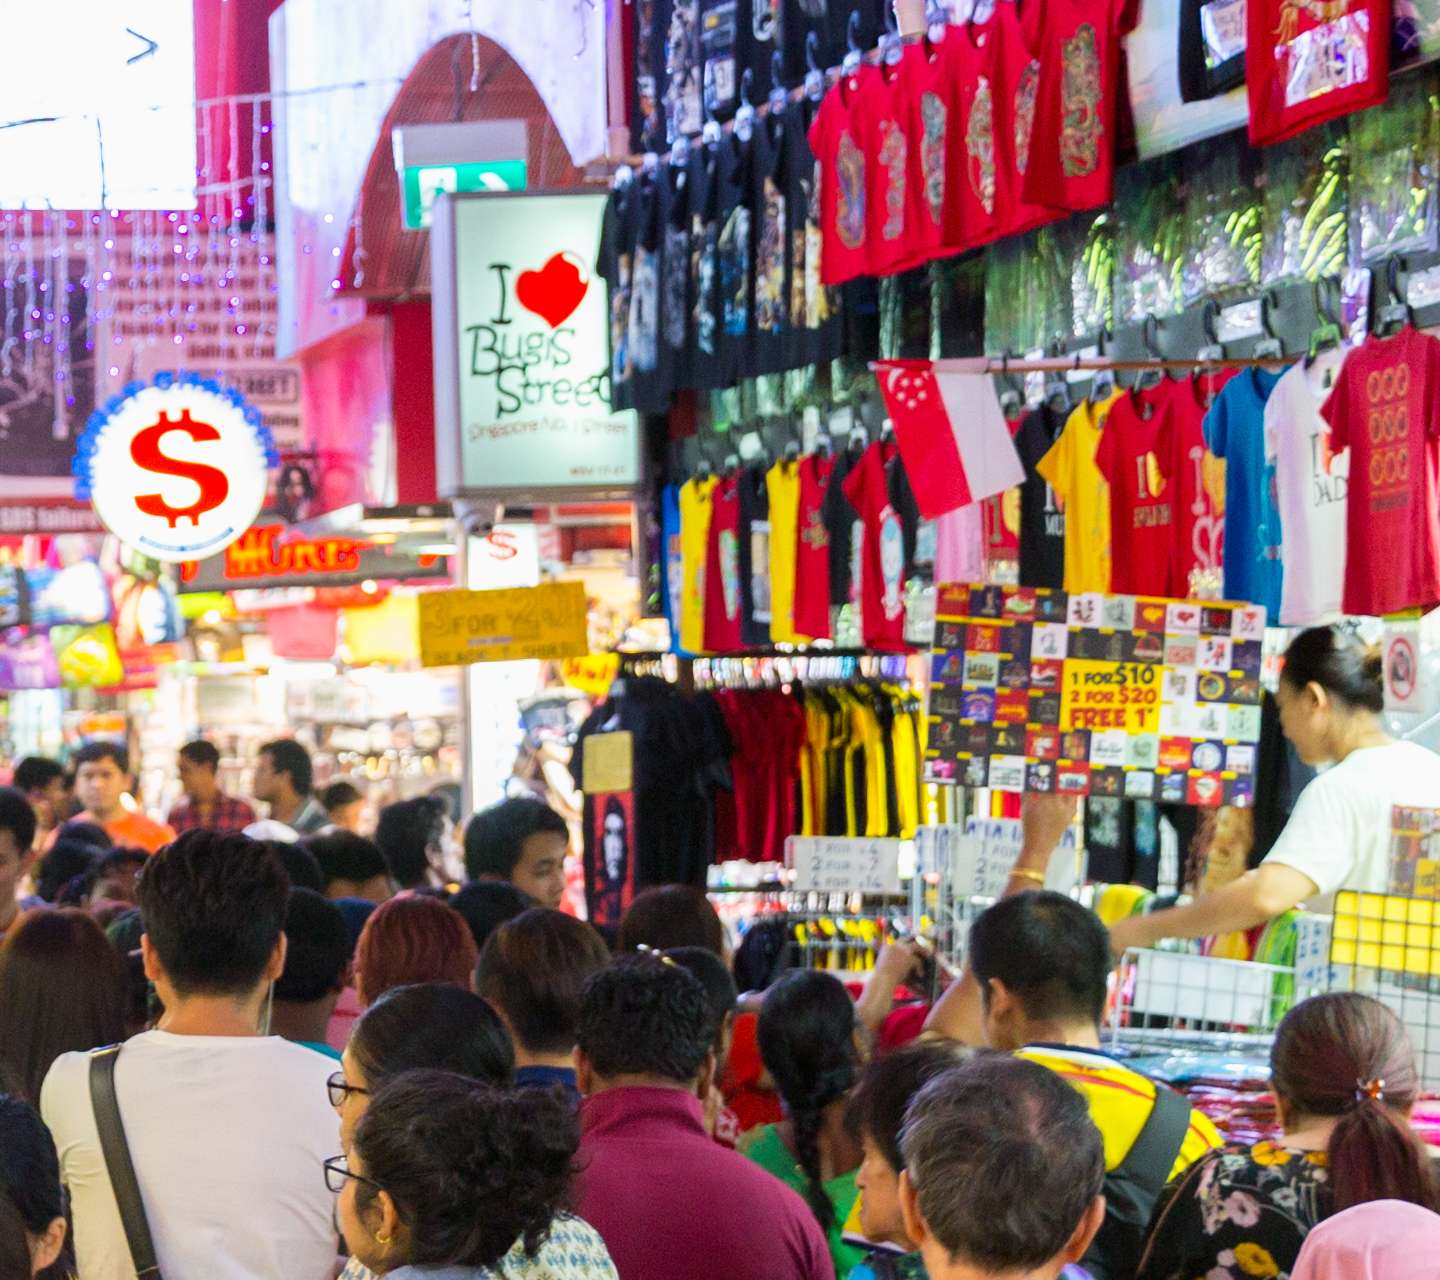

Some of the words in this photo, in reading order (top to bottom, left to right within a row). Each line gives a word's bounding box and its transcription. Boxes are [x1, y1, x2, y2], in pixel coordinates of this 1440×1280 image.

[489, 264, 511, 324] I
[129, 407, 229, 529] $
[1072, 673, 1078, 685] 1
[1084, 673, 1113, 685] FOR
[1114, 663, 1154, 686] $10
[1071, 690, 1079, 702] 2
[1085, 691, 1114, 703] FOR
[1118, 686, 1157, 705] $20
[1070, 708, 1126, 728] FREE
